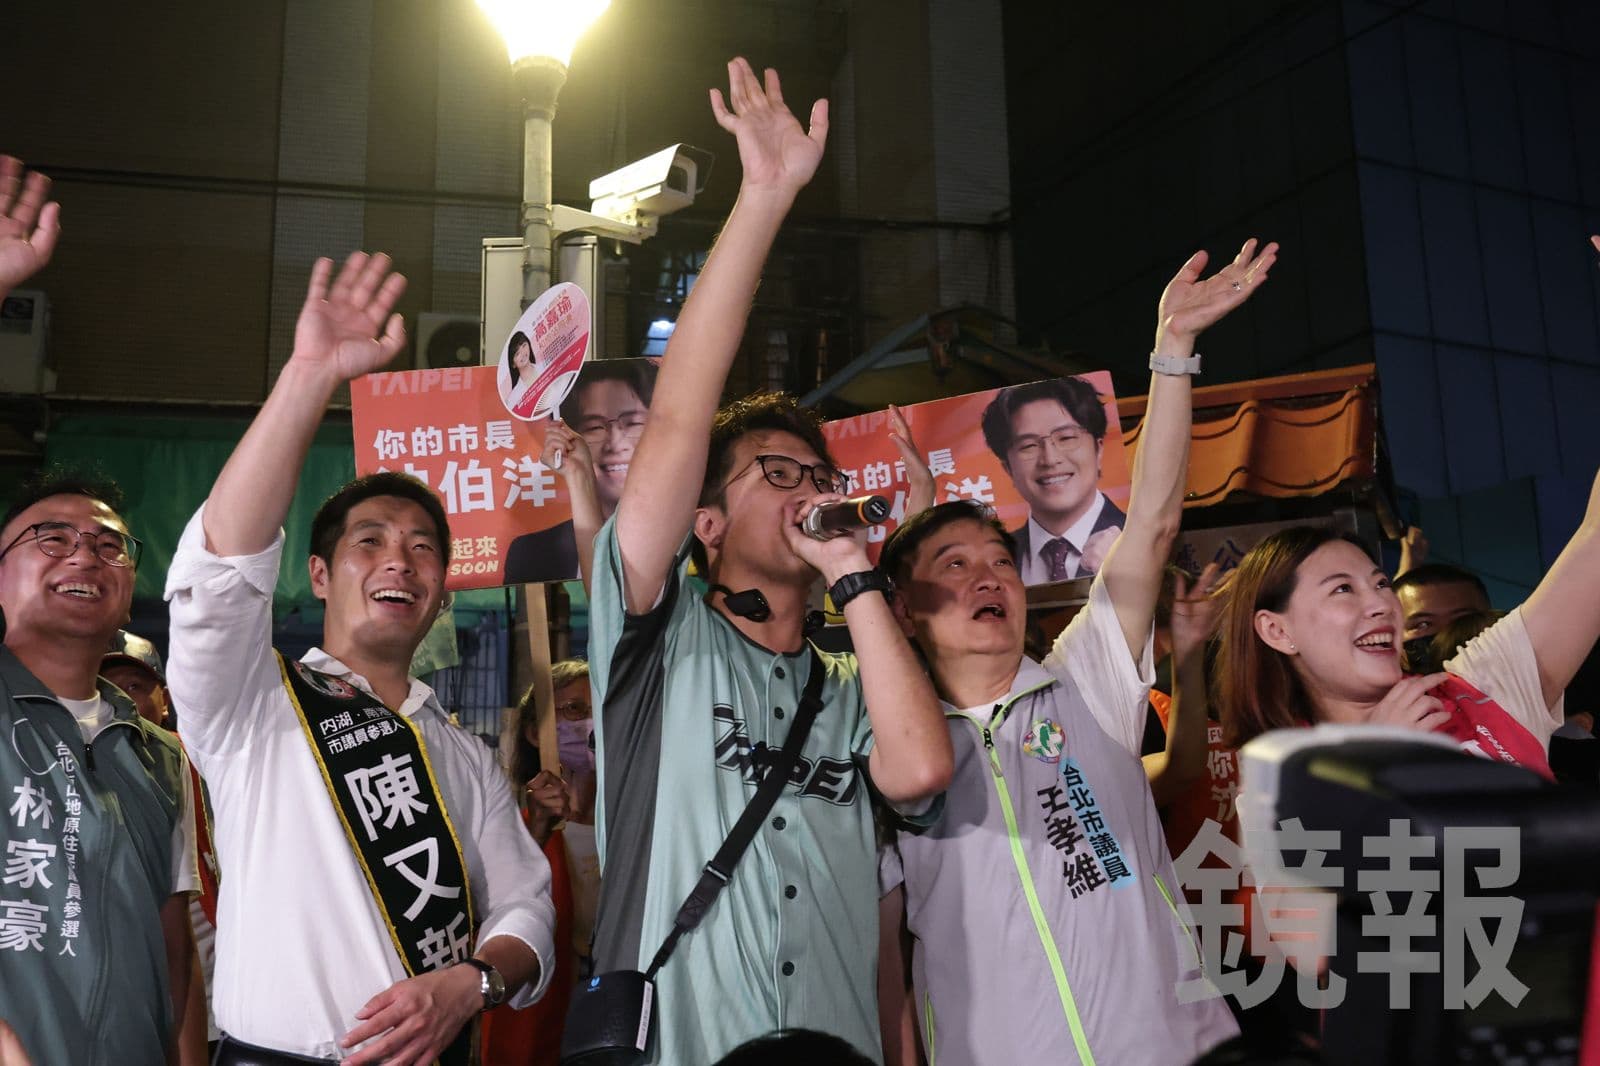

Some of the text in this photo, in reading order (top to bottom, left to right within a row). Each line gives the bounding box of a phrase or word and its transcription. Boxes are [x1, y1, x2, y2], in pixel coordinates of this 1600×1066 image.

[367, 368, 473, 396] TAIPEI
[373, 420, 516, 460] 你的市長
[450, 560, 499, 576] SOON
[327, 719, 405, 755] 市議員參選人
[1037, 785, 1107, 899] 王孝維
[1063, 764, 1131, 883] 台北市議員
[0, 776, 57, 952] 林家豪
[344, 753, 472, 972] 陳又新
